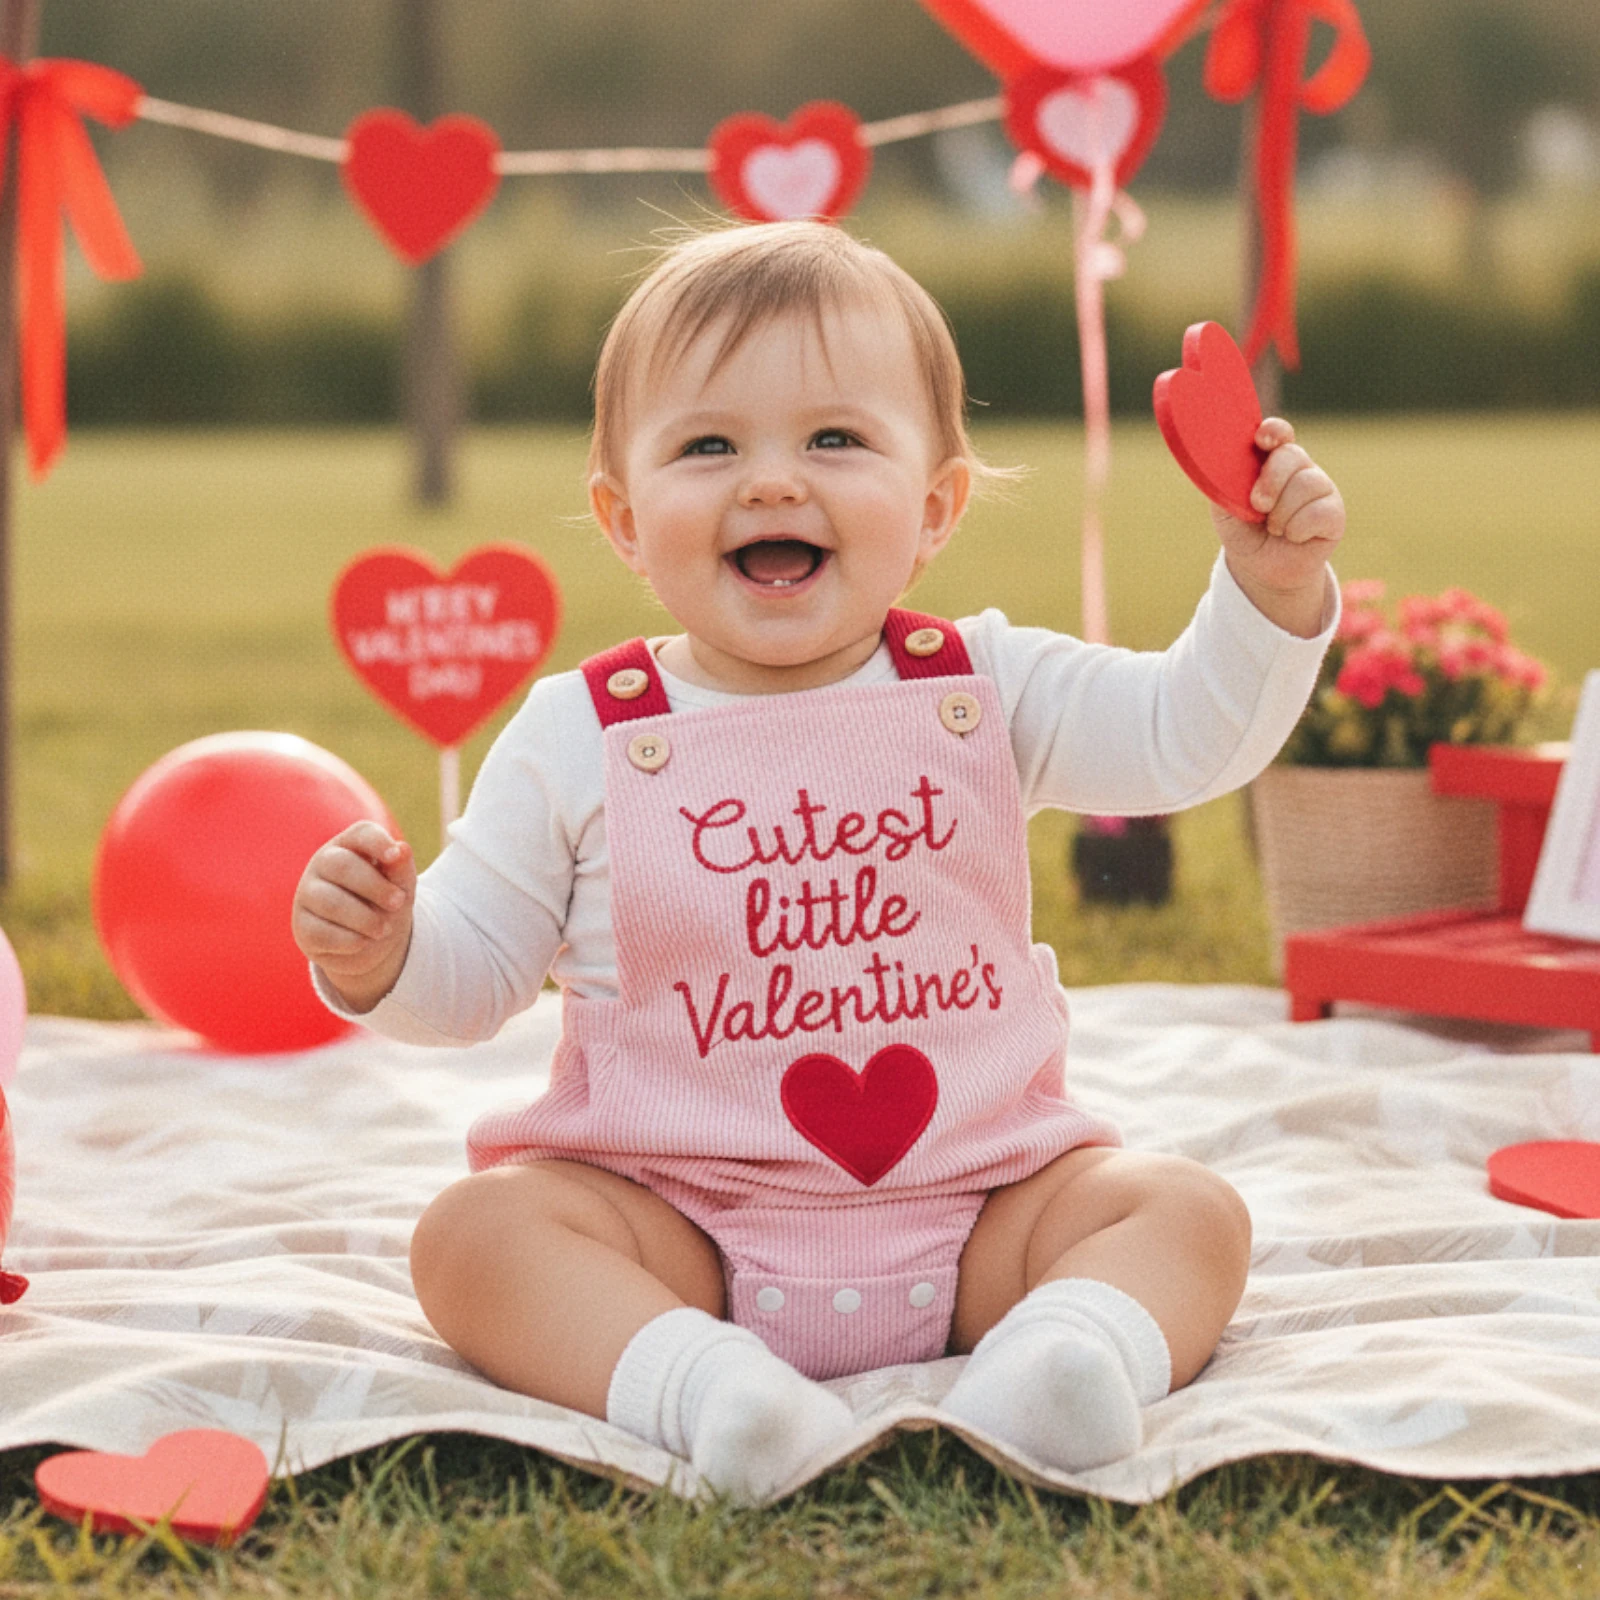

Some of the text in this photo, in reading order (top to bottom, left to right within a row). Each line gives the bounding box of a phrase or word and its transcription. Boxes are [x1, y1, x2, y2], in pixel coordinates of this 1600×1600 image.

[679, 775, 958, 874] Cutest
[746, 865, 921, 958] little
[673, 944, 1003, 1059] Valentine's
